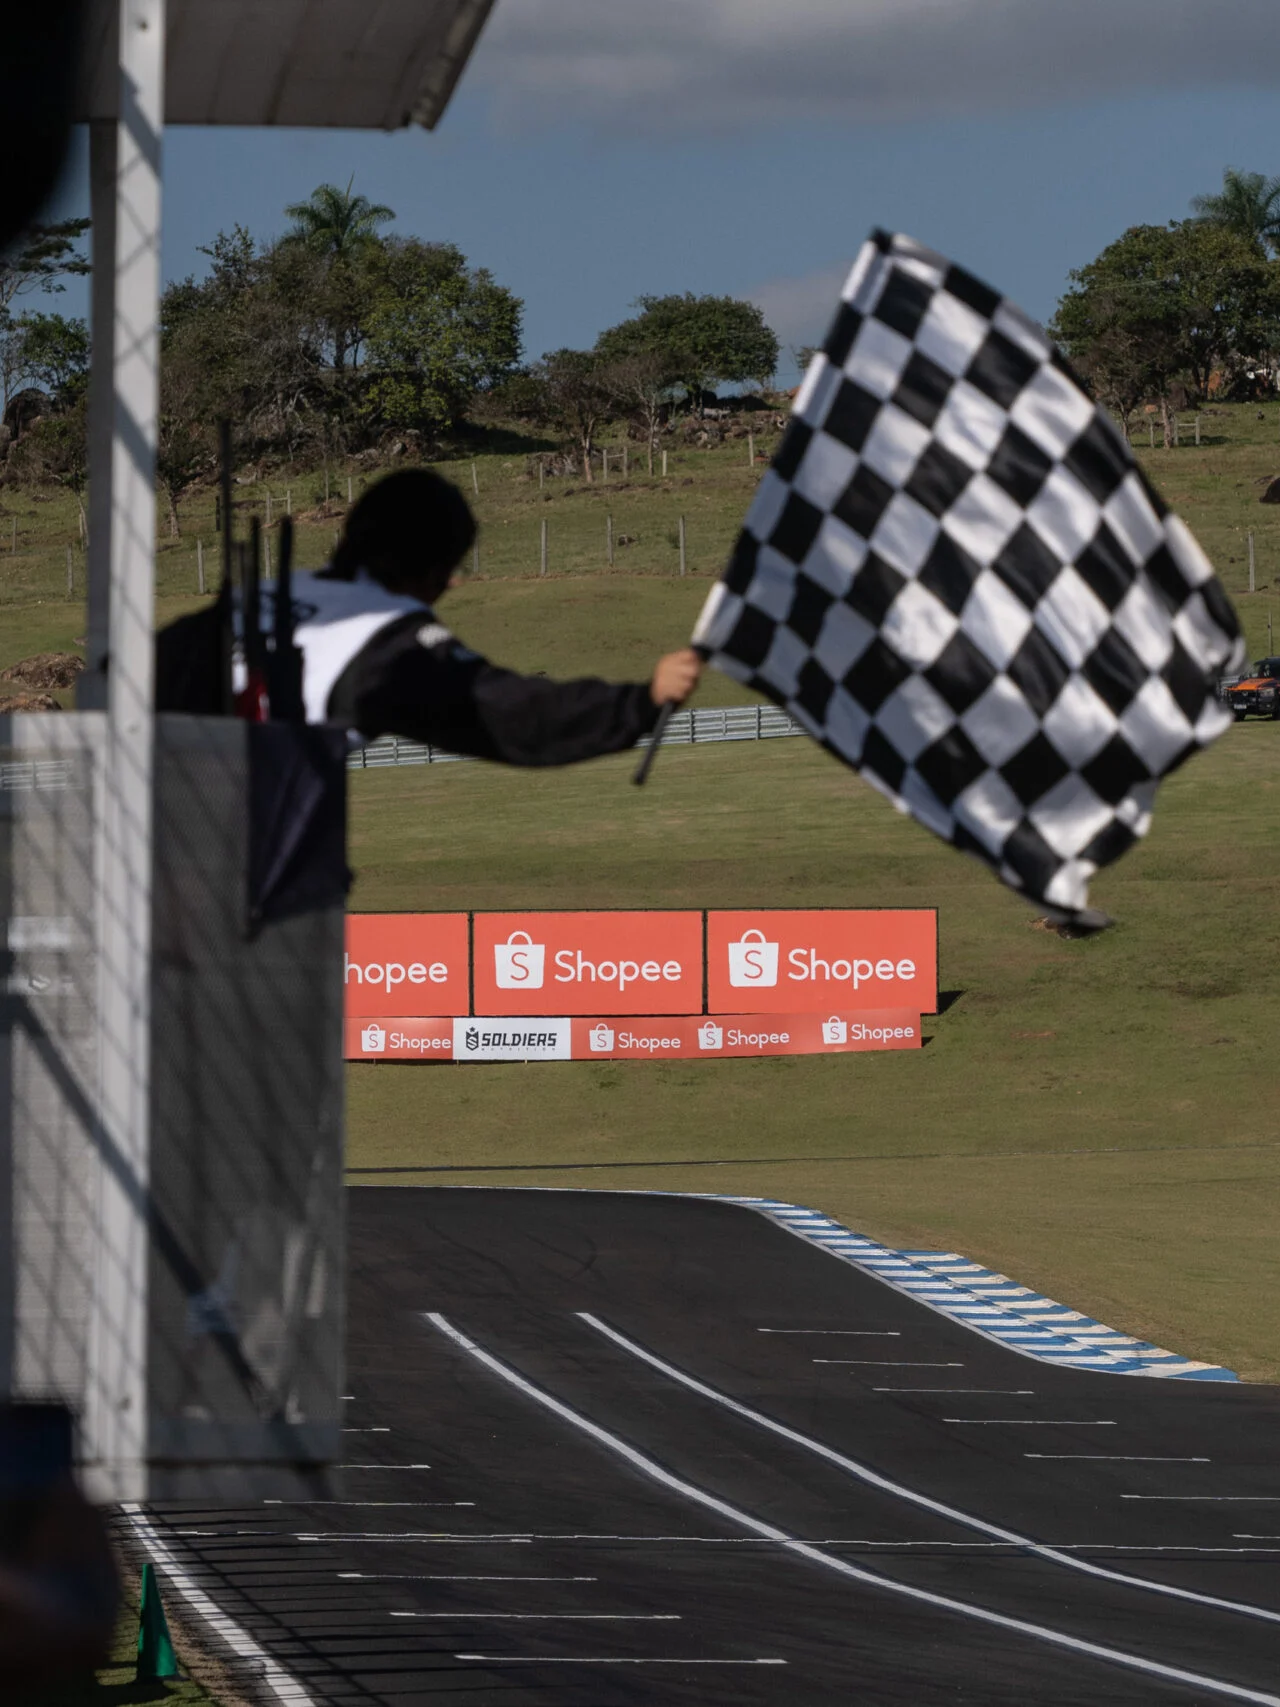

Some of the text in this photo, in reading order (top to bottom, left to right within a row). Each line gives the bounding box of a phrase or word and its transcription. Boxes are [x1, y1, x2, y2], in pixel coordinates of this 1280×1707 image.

[344, 952, 448, 993] hopee
[554, 950, 681, 991] Shopee
[788, 948, 916, 989] Shopee
[389, 1032, 452, 1053] Shopee
[481, 1033, 557, 1047] SOLDIERS
[618, 1032, 681, 1052] Shopee
[727, 1030, 790, 1048] Shopee
[851, 1023, 915, 1042] Shopee
